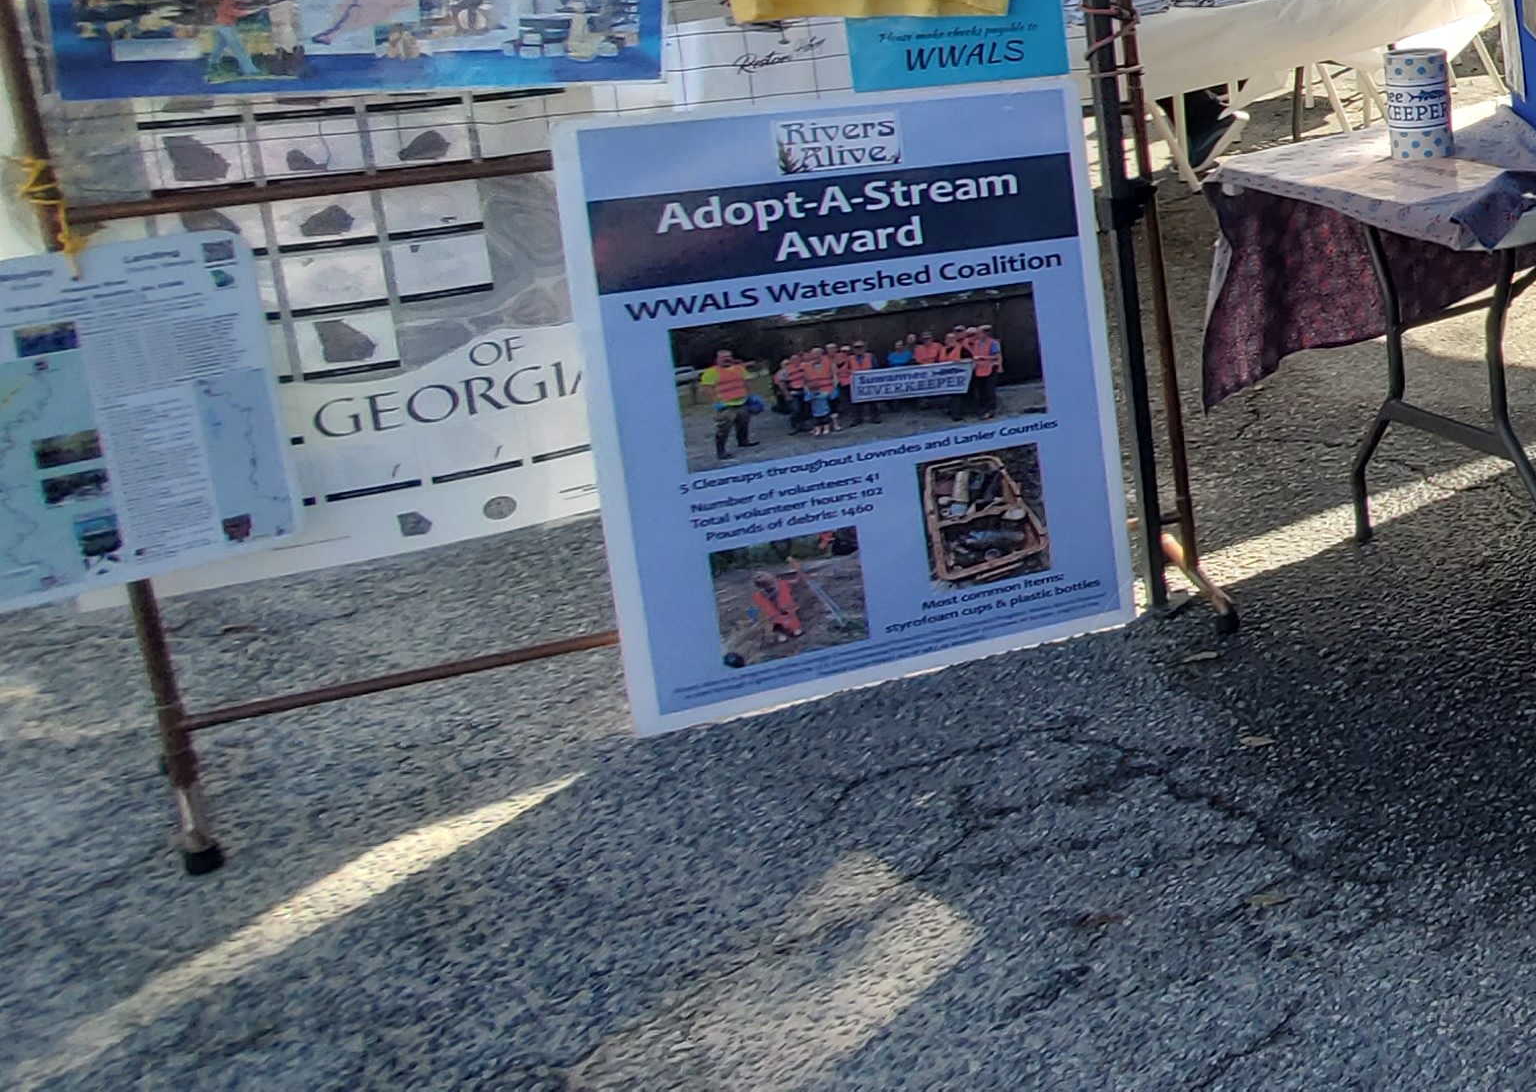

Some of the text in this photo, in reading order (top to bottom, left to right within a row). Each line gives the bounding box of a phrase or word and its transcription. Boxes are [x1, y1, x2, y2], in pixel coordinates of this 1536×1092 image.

[905, 39, 1025, 71] WWALS
[781, 119, 895, 146] Rivers
[800, 142, 888, 171] Alive
[656, 172, 1018, 234] Adopt-A-Stream
[775, 216, 923, 263] Award
[625, 252, 1062, 322] WWALS Watershed Coalition
[469, 336, 523, 367] OF
[680, 418, 1058, 495] 5 Cleanups throughout Lowndes and Lanier Counties
[689, 486, 884, 530] Total volunteer hours: 102
[690, 472, 880, 514] Number of volunteers: 41
[706, 524, 764, 542] Pounds
[767, 518, 784, 532] of
[786, 507, 839, 527] debris:
[885, 611, 959, 635] styrofoam
[961, 602, 993, 618] cups
[1010, 588, 1053, 609] plastic
[1054, 578, 1101, 597] bottles
[922, 573, 1065, 611] Most common items:
